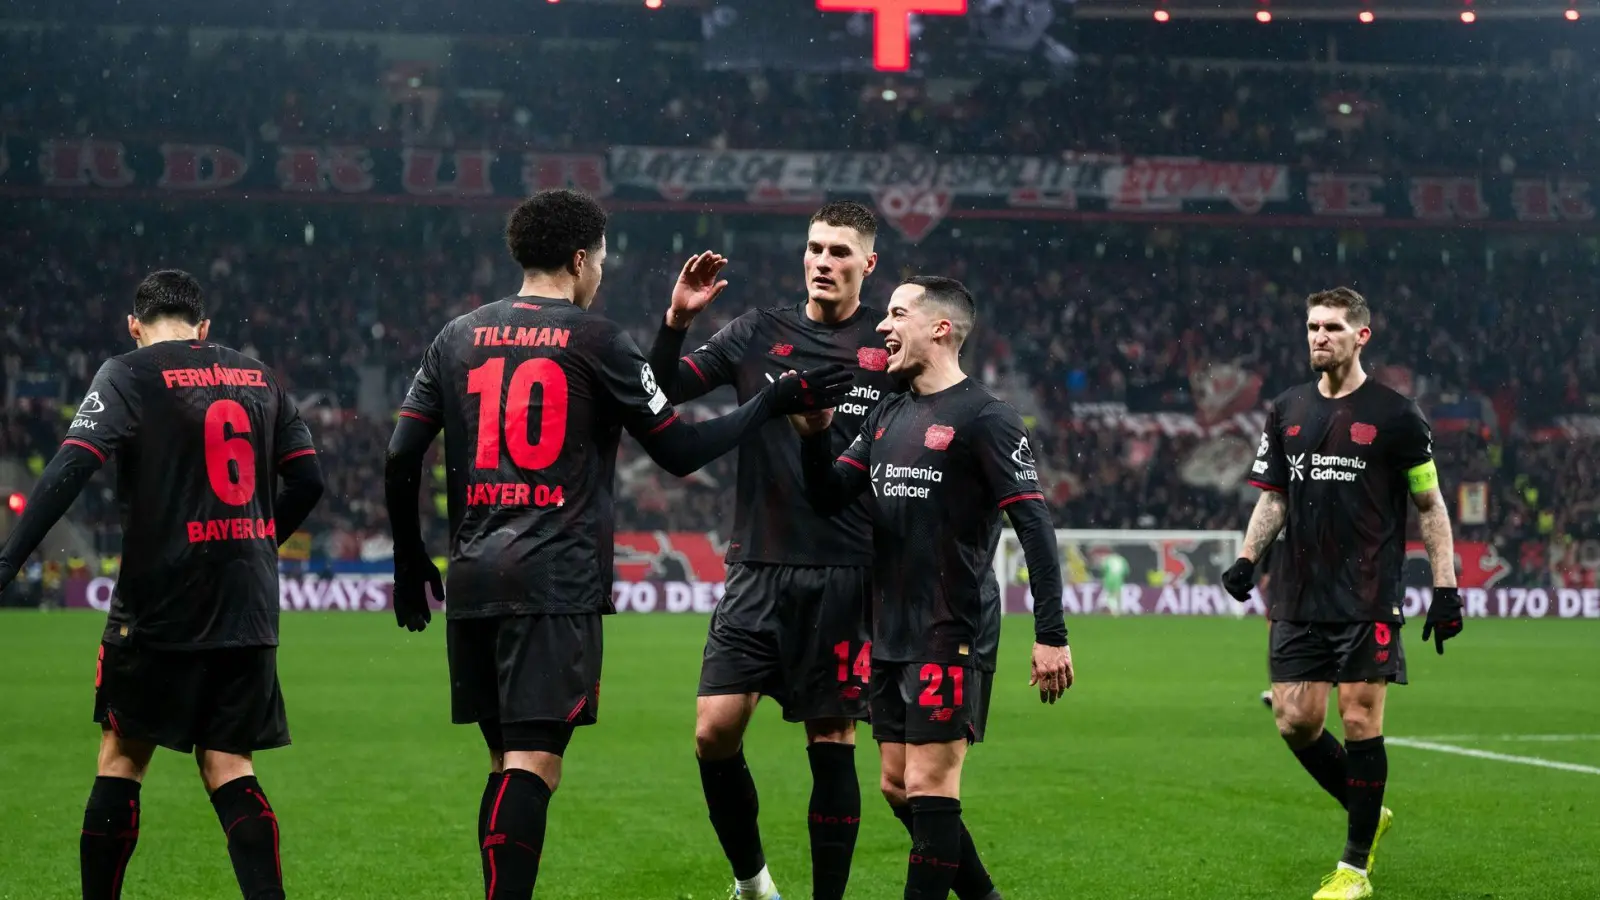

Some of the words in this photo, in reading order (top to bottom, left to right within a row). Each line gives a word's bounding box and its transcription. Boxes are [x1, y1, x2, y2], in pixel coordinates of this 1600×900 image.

[880, 190, 943, 215] 04
[473, 326, 571, 348] TILLMAN
[162, 363, 268, 389] FERNÁNDEZ
[845, 384, 881, 401] enia
[70, 418, 98, 431] EDAX
[467, 357, 569, 471] 10
[204, 399, 256, 507] 6
[885, 463, 943, 483] Barmenia
[1014, 469, 1038, 481] NIED
[534, 484, 565, 507] 04
[883, 482, 930, 499] Gothaer
[186, 518, 255, 544] BAYER
[256, 518, 277, 540] 04
[280, 577, 387, 611] RWAYS
[612, 580, 658, 614] 70
[1155, 583, 1268, 616] AIRWA
[1402, 586, 1489, 617] OVR
[1497, 587, 1549, 618] 170
[833, 639, 873, 684] 14
[918, 662, 964, 706] 21
